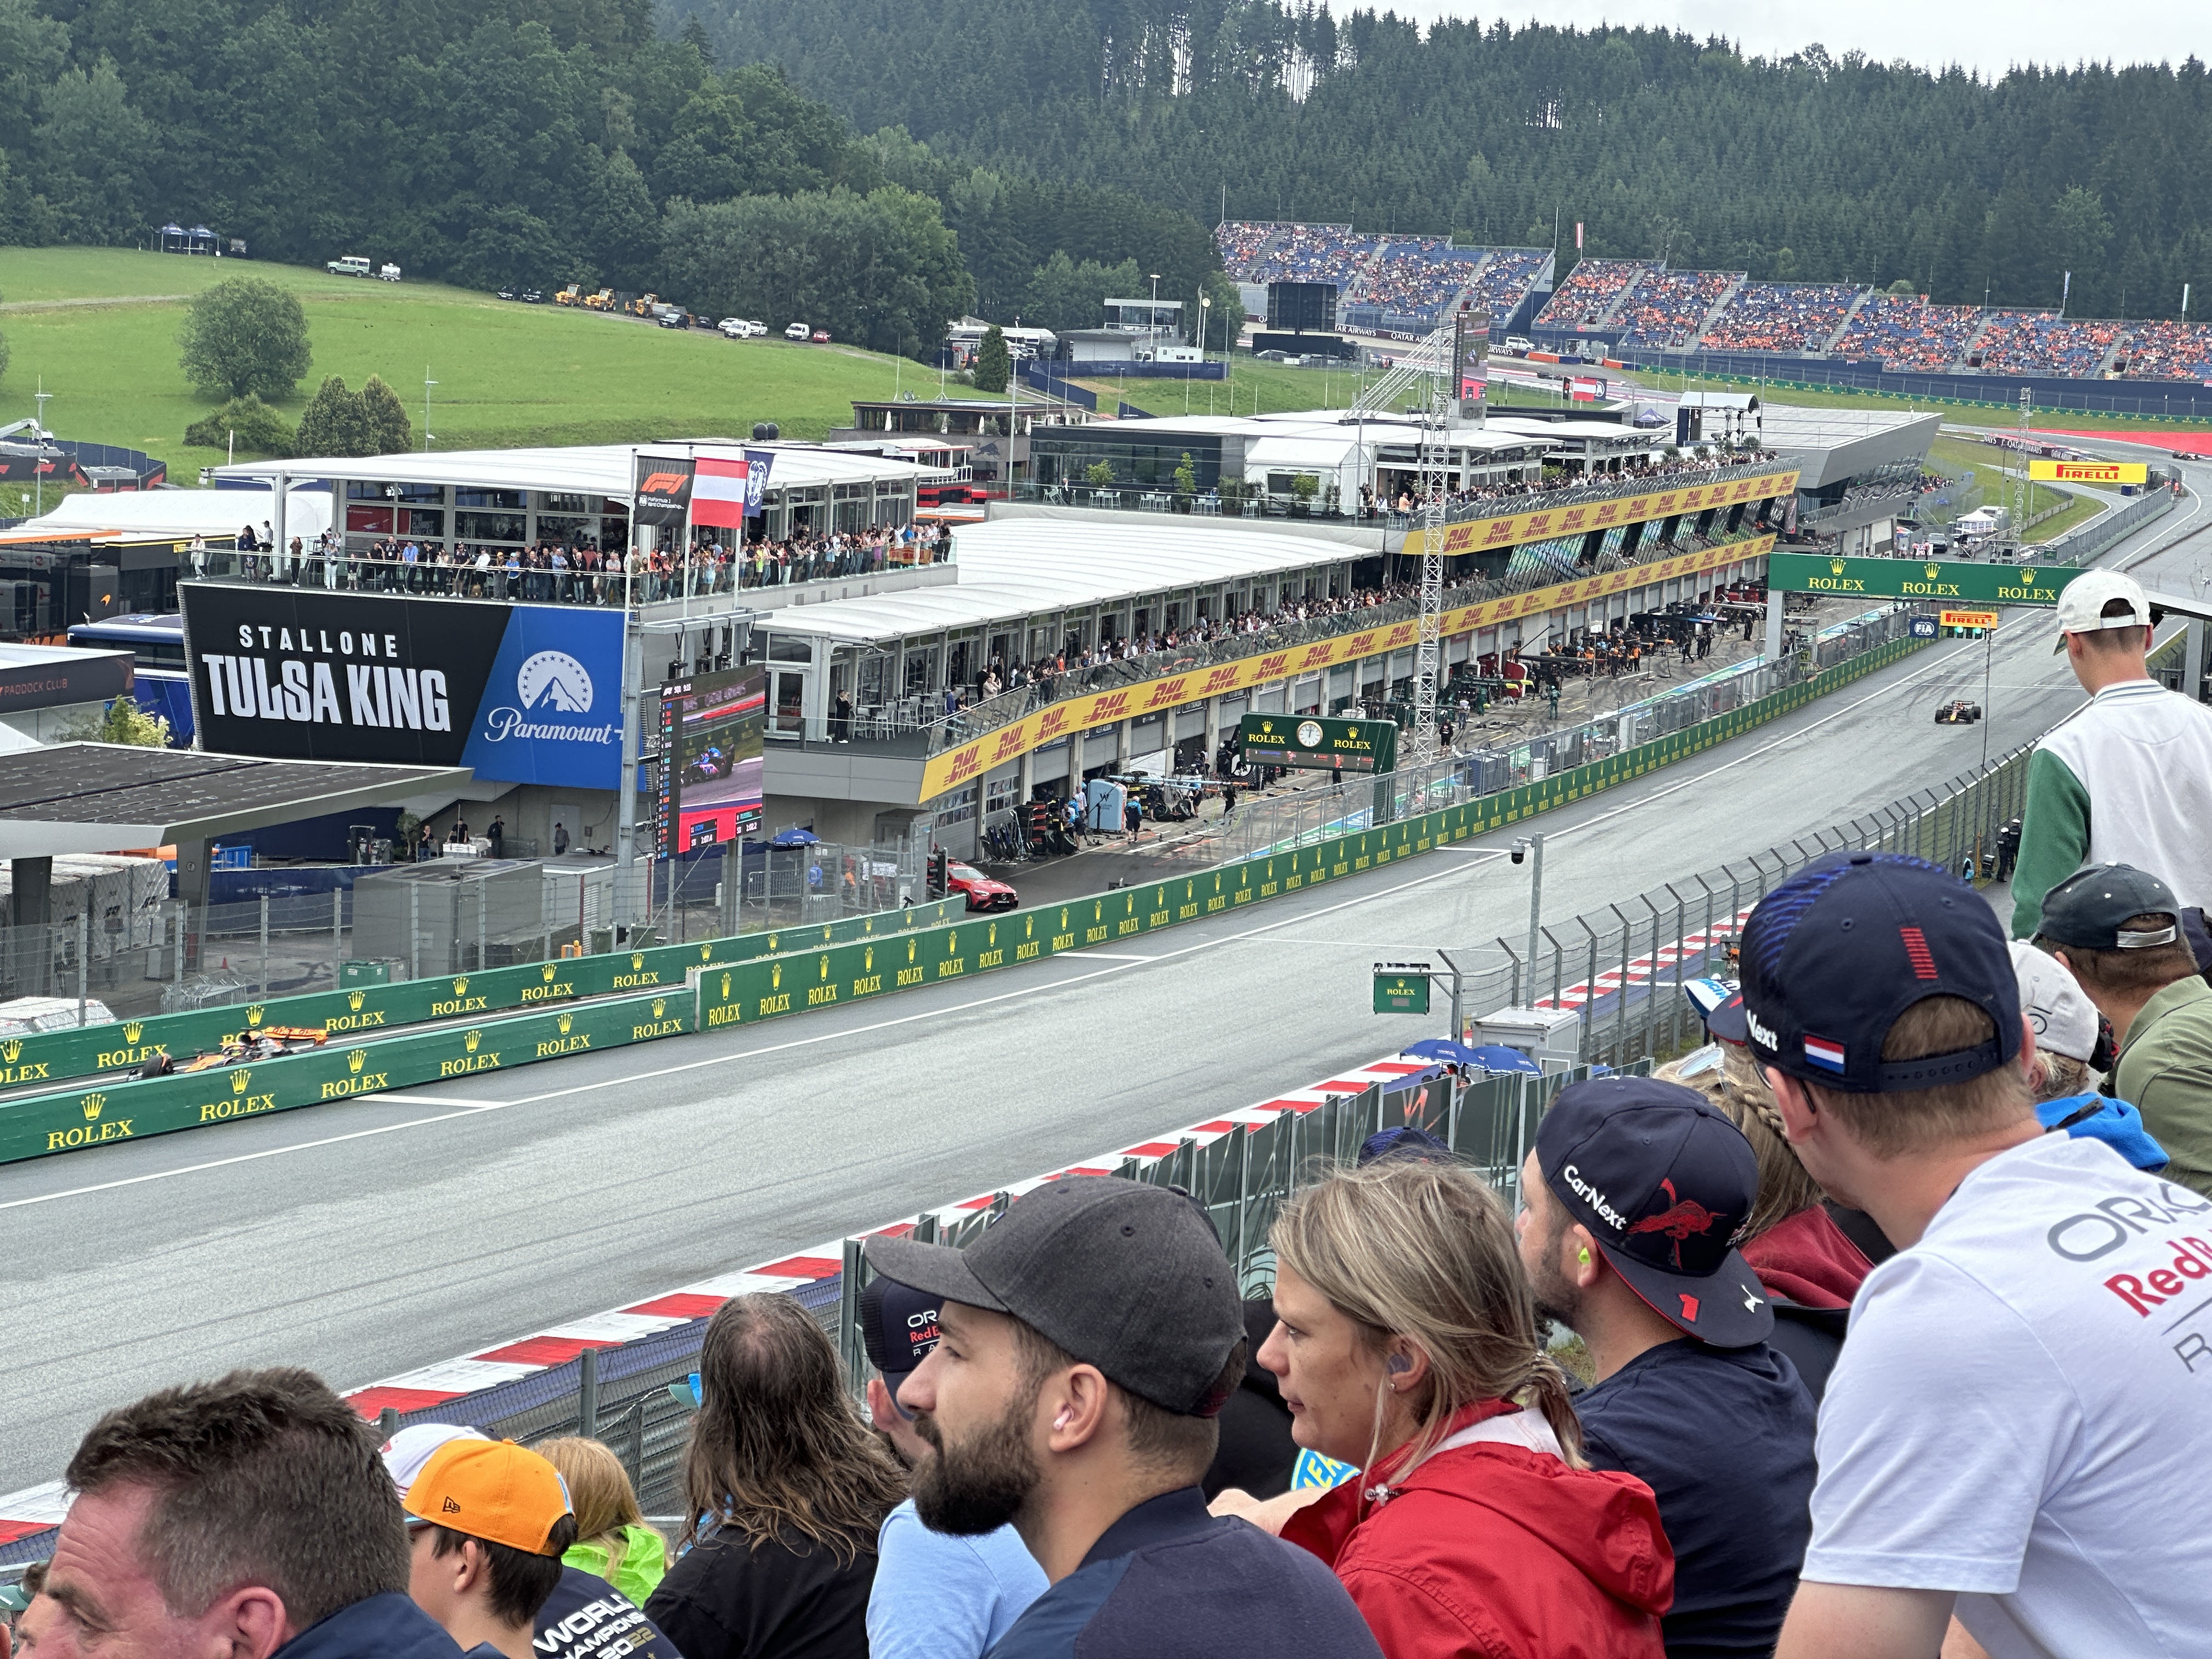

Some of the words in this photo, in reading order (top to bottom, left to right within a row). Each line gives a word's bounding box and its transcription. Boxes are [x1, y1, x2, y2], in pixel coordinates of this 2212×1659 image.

[1348, 325, 1377, 337] AIRWAYS
[1391, 332, 1414, 342] QATAR
[2056, 464, 2120, 480] PIRELLI
[1595, 504, 1618, 524] DHL
[1627, 499, 1647, 520] DHL
[1524, 515, 1550, 537] DHL
[1561, 509, 1585, 531] DHL
[1444, 527, 1473, 551] DHL
[1485, 521, 1514, 544] DHL
[1556, 585, 1576, 603] DHL
[1584, 578, 1602, 597] DHL
[1809, 578, 1865, 591] ROLEX
[1902, 582, 1960, 596] ROLEX
[1997, 586, 2056, 600] ROLEX
[1460, 607, 1483, 628] DHL
[1494, 600, 1515, 620] DHL
[239, 624, 398, 658] STALLONE
[1347, 633, 1374, 656] DHL
[1387, 624, 1413, 647] DHL
[1303, 643, 1333, 668] DHL
[1256, 654, 1287, 680] DHL
[4, 681, 44, 696] PADDOCK
[46, 678, 67, 691] CLUB
[1204, 666, 1238, 692] DHL
[201, 653, 342, 725] TULSA
[346, 664, 452, 732] KING
[1149, 679, 1185, 707] DHL
[1089, 692, 1128, 723] DHL
[1037, 707, 1065, 740] DHL
[996, 725, 1023, 760] DHL
[1248, 733, 1285, 744] ROLEX
[1334, 740, 1370, 749] ROLEX
[949, 746, 979, 783] DHL
[1334, 862, 1347, 875] ROLEX
[1356, 855, 1369, 869] ROLEX
[1286, 874, 1301, 889] ROLEX
[1310, 868, 1325, 882] ROLEX
[1235, 888, 1251, 903] ROLEX
[1261, 881, 1277, 896] ROLEX
[1180, 902, 1197, 918] ROLEX
[1208, 895, 1225, 911] ROLEX
[1119, 917, 1138, 934] ROLEX
[1150, 910, 1169, 926] ROLEX
[1053, 933, 1074, 950] ROLEX
[1087, 925, 1107, 942] ROLEX
[979, 949, 1002, 968] ROLEX
[1017, 941, 1039, 959] ROLEX
[898, 966, 923, 986] ROLEX
[939, 958, 963, 977] ROLEX
[613, 972, 659, 988] ROLEX
[854, 975, 881, 995] ROLEX
[521, 983, 574, 1001] ROLEX
[809, 984, 837, 1005] ROLEX
[431, 996, 488, 1015] ROLEX
[708, 1003, 740, 1025] ROLEX
[760, 994, 790, 1014] ROLEX
[325, 1011, 385, 1032] ROLEX
[633, 1018, 682, 1040] ROLEX
[537, 1035, 591, 1057] ROLEX
[97, 1044, 167, 1069] ROLEX
[441, 1053, 500, 1076] ROLEX
[321, 1073, 388, 1099] ROLEX
[199, 1093, 275, 1121] ROLEX
[47, 1119, 133, 1150] ROLEX
[1564, 1164, 1627, 1231] CarNext
